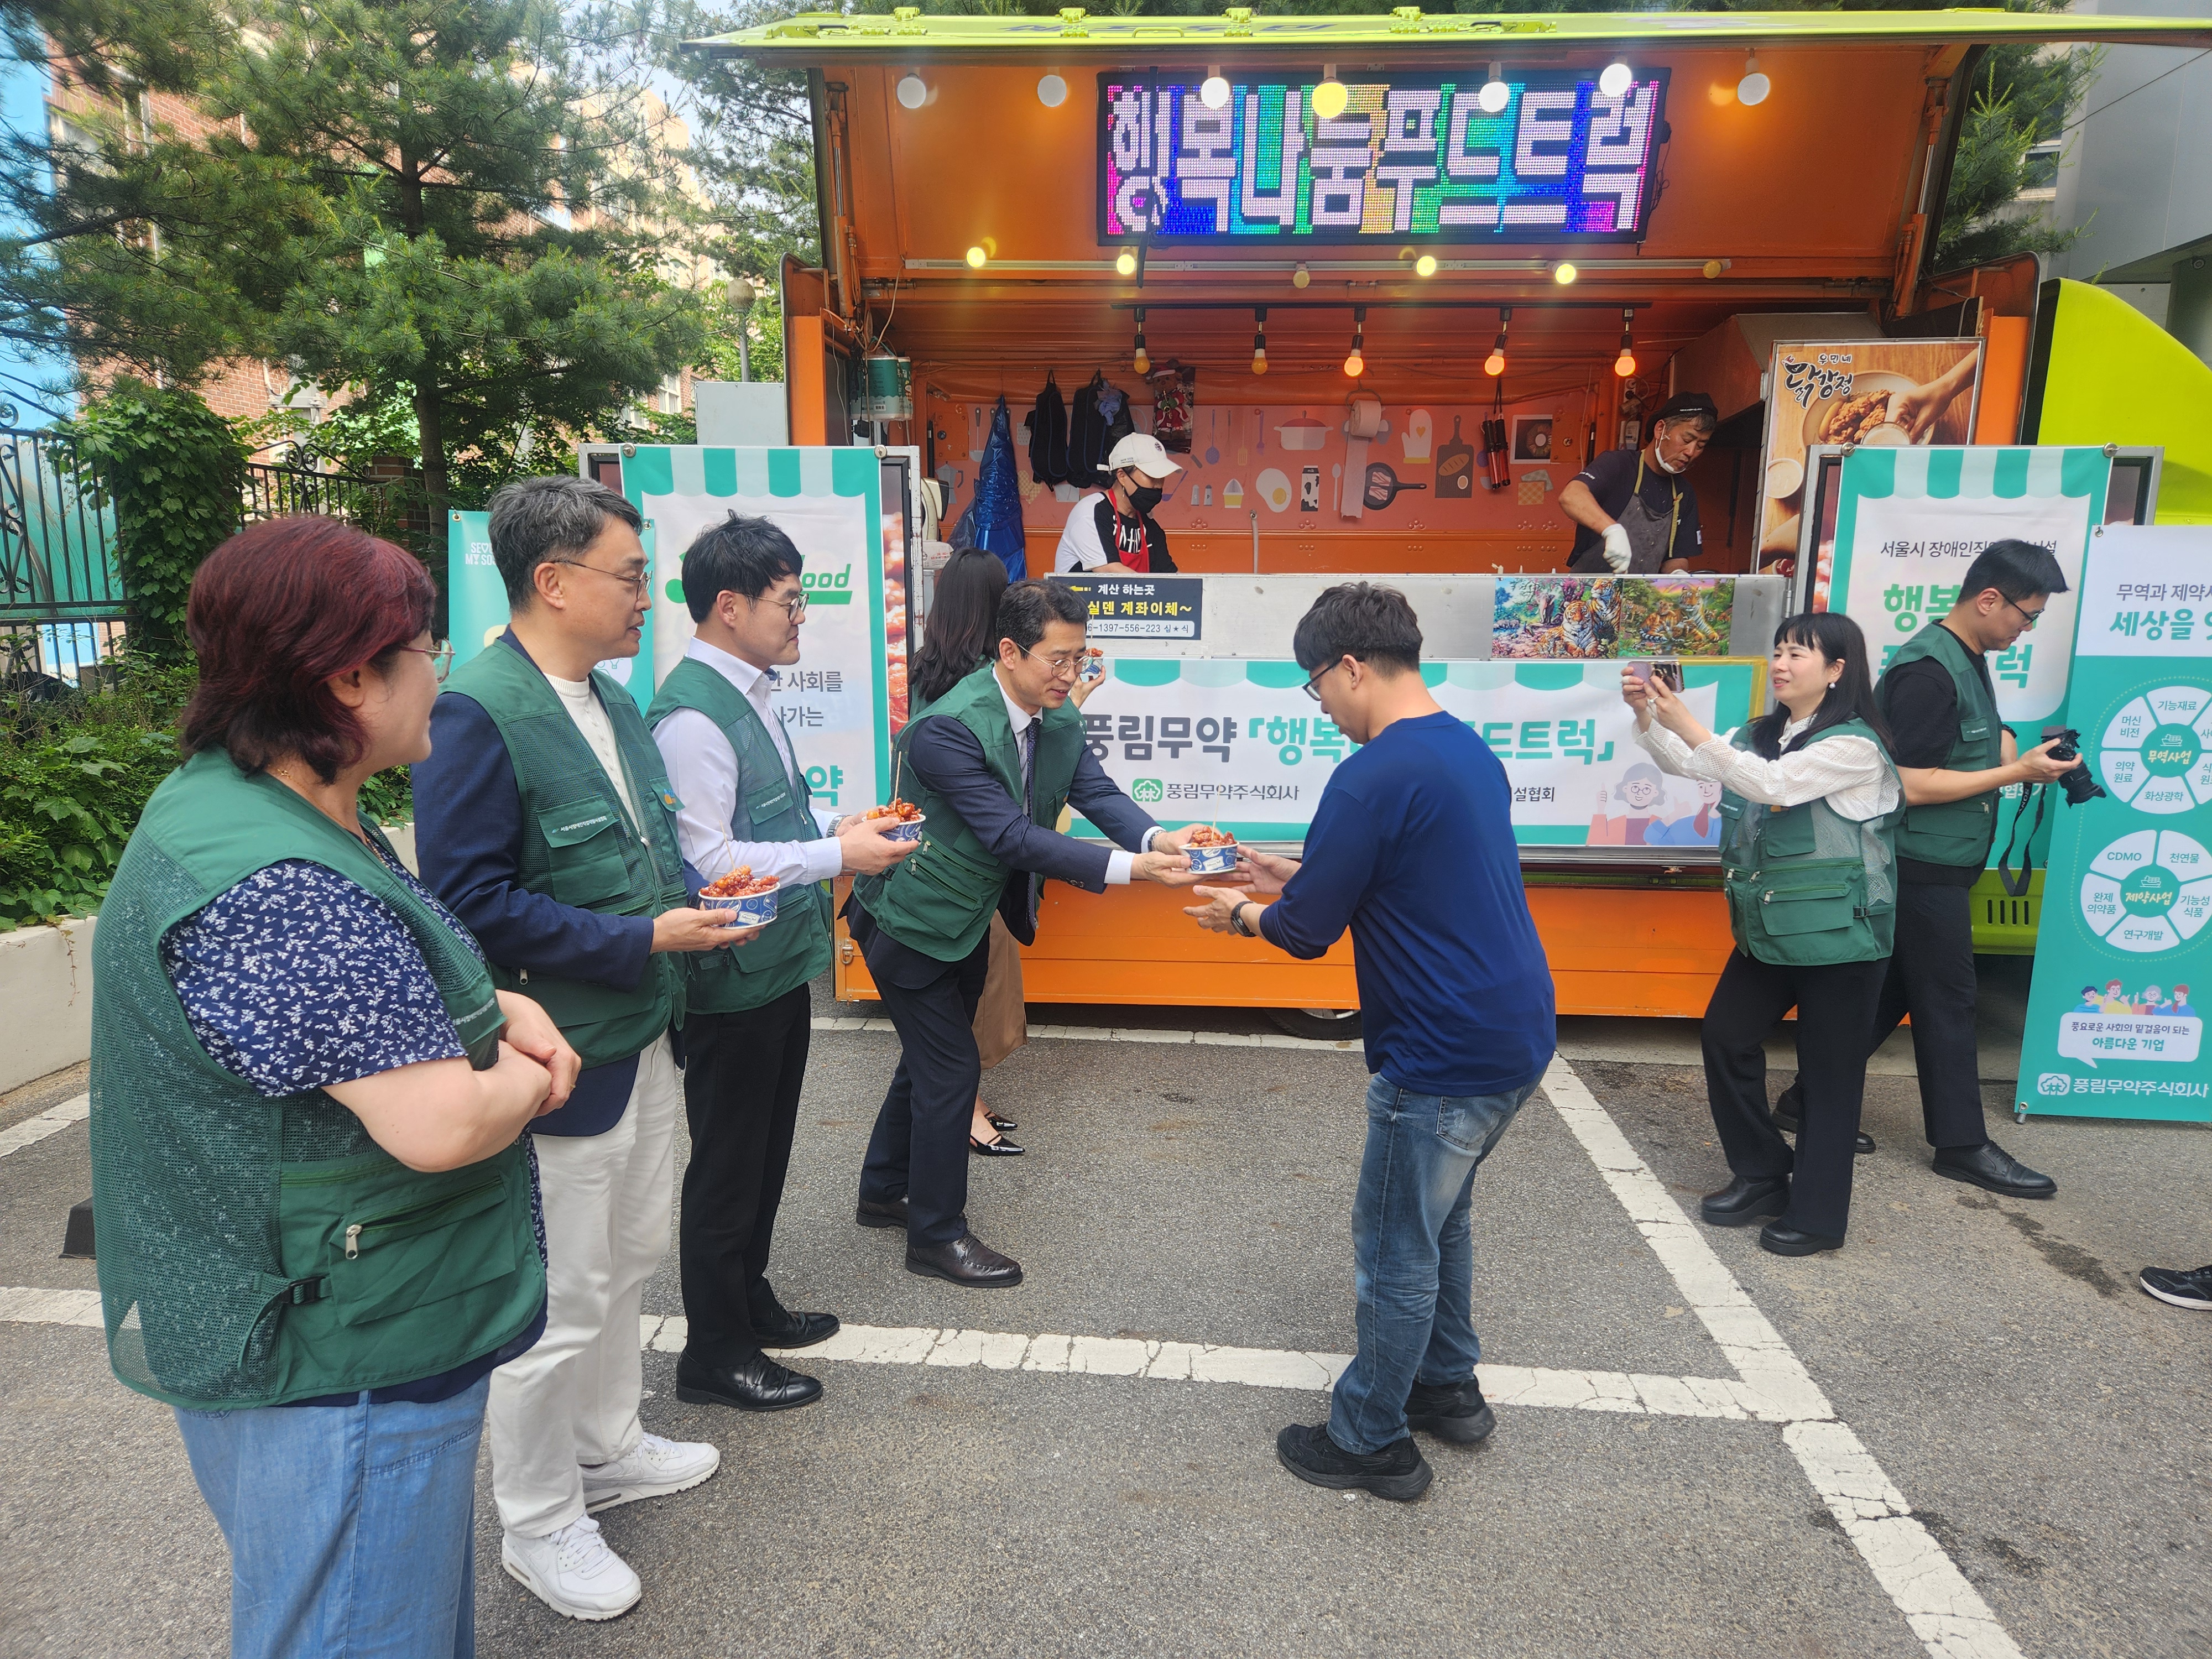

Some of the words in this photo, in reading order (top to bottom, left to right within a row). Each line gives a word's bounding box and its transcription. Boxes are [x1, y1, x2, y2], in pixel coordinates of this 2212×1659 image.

[1818, 353, 1852, 364] 우민네
[1783, 356, 1853, 408] 닭강정
[1881, 541, 1925, 557] 서울시
[1098, 584, 1119, 595] 계산
[1123, 584, 1155, 596] 하는곳
[2116, 583, 2167, 601] 무역과
[1088, 601, 1115, 615] 실덴
[1087, 623, 1160, 633] 6-1397-556-223
[2109, 608, 2195, 641] 세상을
[787, 671, 843, 692] 사회를
[2158, 701, 2197, 711] 기능재료
[2121, 716, 2141, 726] 머신
[1082, 713, 1237, 763] 풍림무약
[2120, 728, 2140, 738] 비전
[2148, 750, 2192, 764] 무역사업
[2115, 761, 2135, 771] 의약
[2114, 773, 2132, 783] 원료
[1167, 783, 1300, 801] 풍림무약주식회사
[2144, 791, 2184, 802] 화상광학
[2107, 852, 2142, 861] CDMO
[2169, 853, 2200, 864] 천연물
[2093, 893, 2113, 902] 완제
[2125, 891, 2172, 905] 제약사업
[2180, 895, 2210, 905] 기능성
[2086, 904, 2116, 915] 의약품
[2183, 907, 2204, 917] 식품
[2124, 930, 2163, 941] 연구개발
[2072, 1021, 2104, 1032] 풍요로운
[2106, 1023, 2133, 1032] 사회의
[2172, 1026, 2190, 1035] 되는
[2092, 1037, 2137, 1050] 아름다운
[2141, 1039, 2164, 1051] 기업
[2073, 1078, 2209, 1098] 풍림무약주식회사
